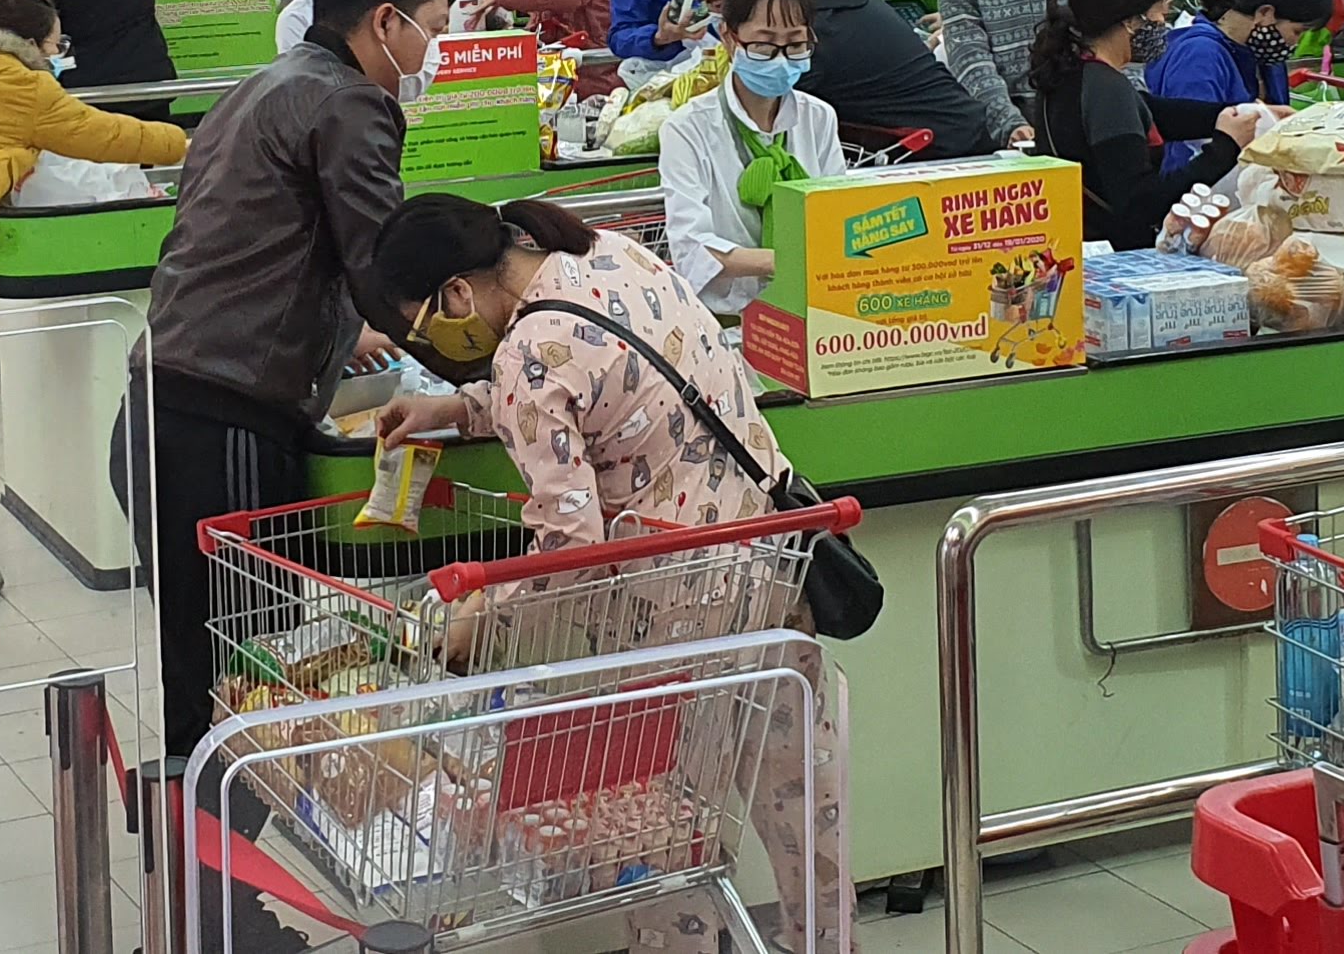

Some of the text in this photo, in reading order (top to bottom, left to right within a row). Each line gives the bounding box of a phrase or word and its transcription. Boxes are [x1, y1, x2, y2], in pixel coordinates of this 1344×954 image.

[454, 42, 522, 64] MIỄN PHÍ
[941, 179, 1043, 214] RINH NGAY
[890, 218, 915, 237] SAY
[943, 198, 1049, 239] XE HÀNG
[863, 268, 880, 277] mua
[859, 291, 949, 314] 600 XE HÀNG
[815, 314, 987, 357] 600.000.000vnd
